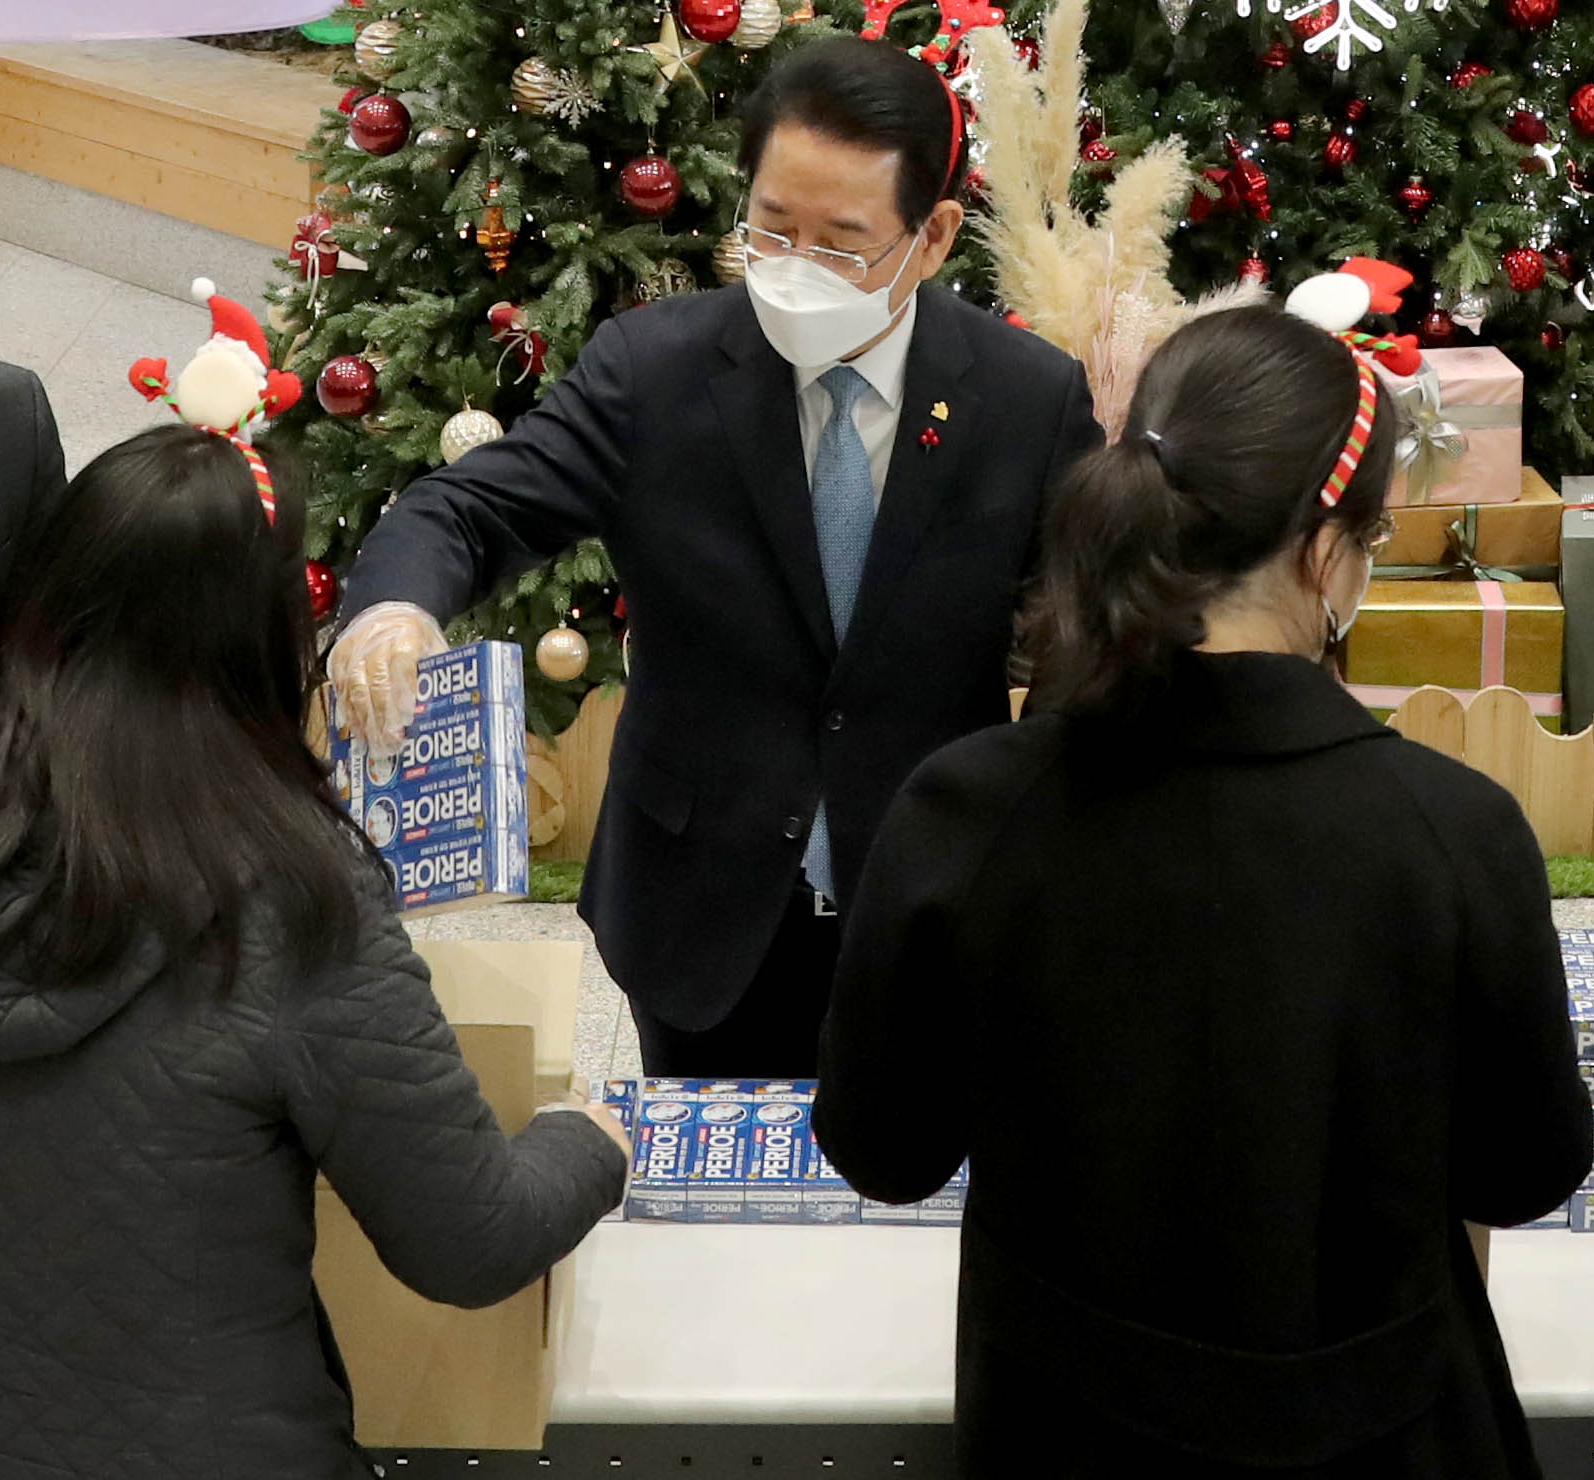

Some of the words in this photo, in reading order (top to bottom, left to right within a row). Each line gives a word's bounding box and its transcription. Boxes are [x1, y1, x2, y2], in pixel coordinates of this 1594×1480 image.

[416, 657, 478, 702] PERIO
[402, 720, 481, 768] PERIOE
[402, 783, 482, 829] PERIOE
[402, 846, 483, 892] PERIOE
[647, 1124, 680, 1179] PERIOE
[705, 1124, 738, 1179] PERIOE
[762, 1125, 794, 1179] PERIOE
